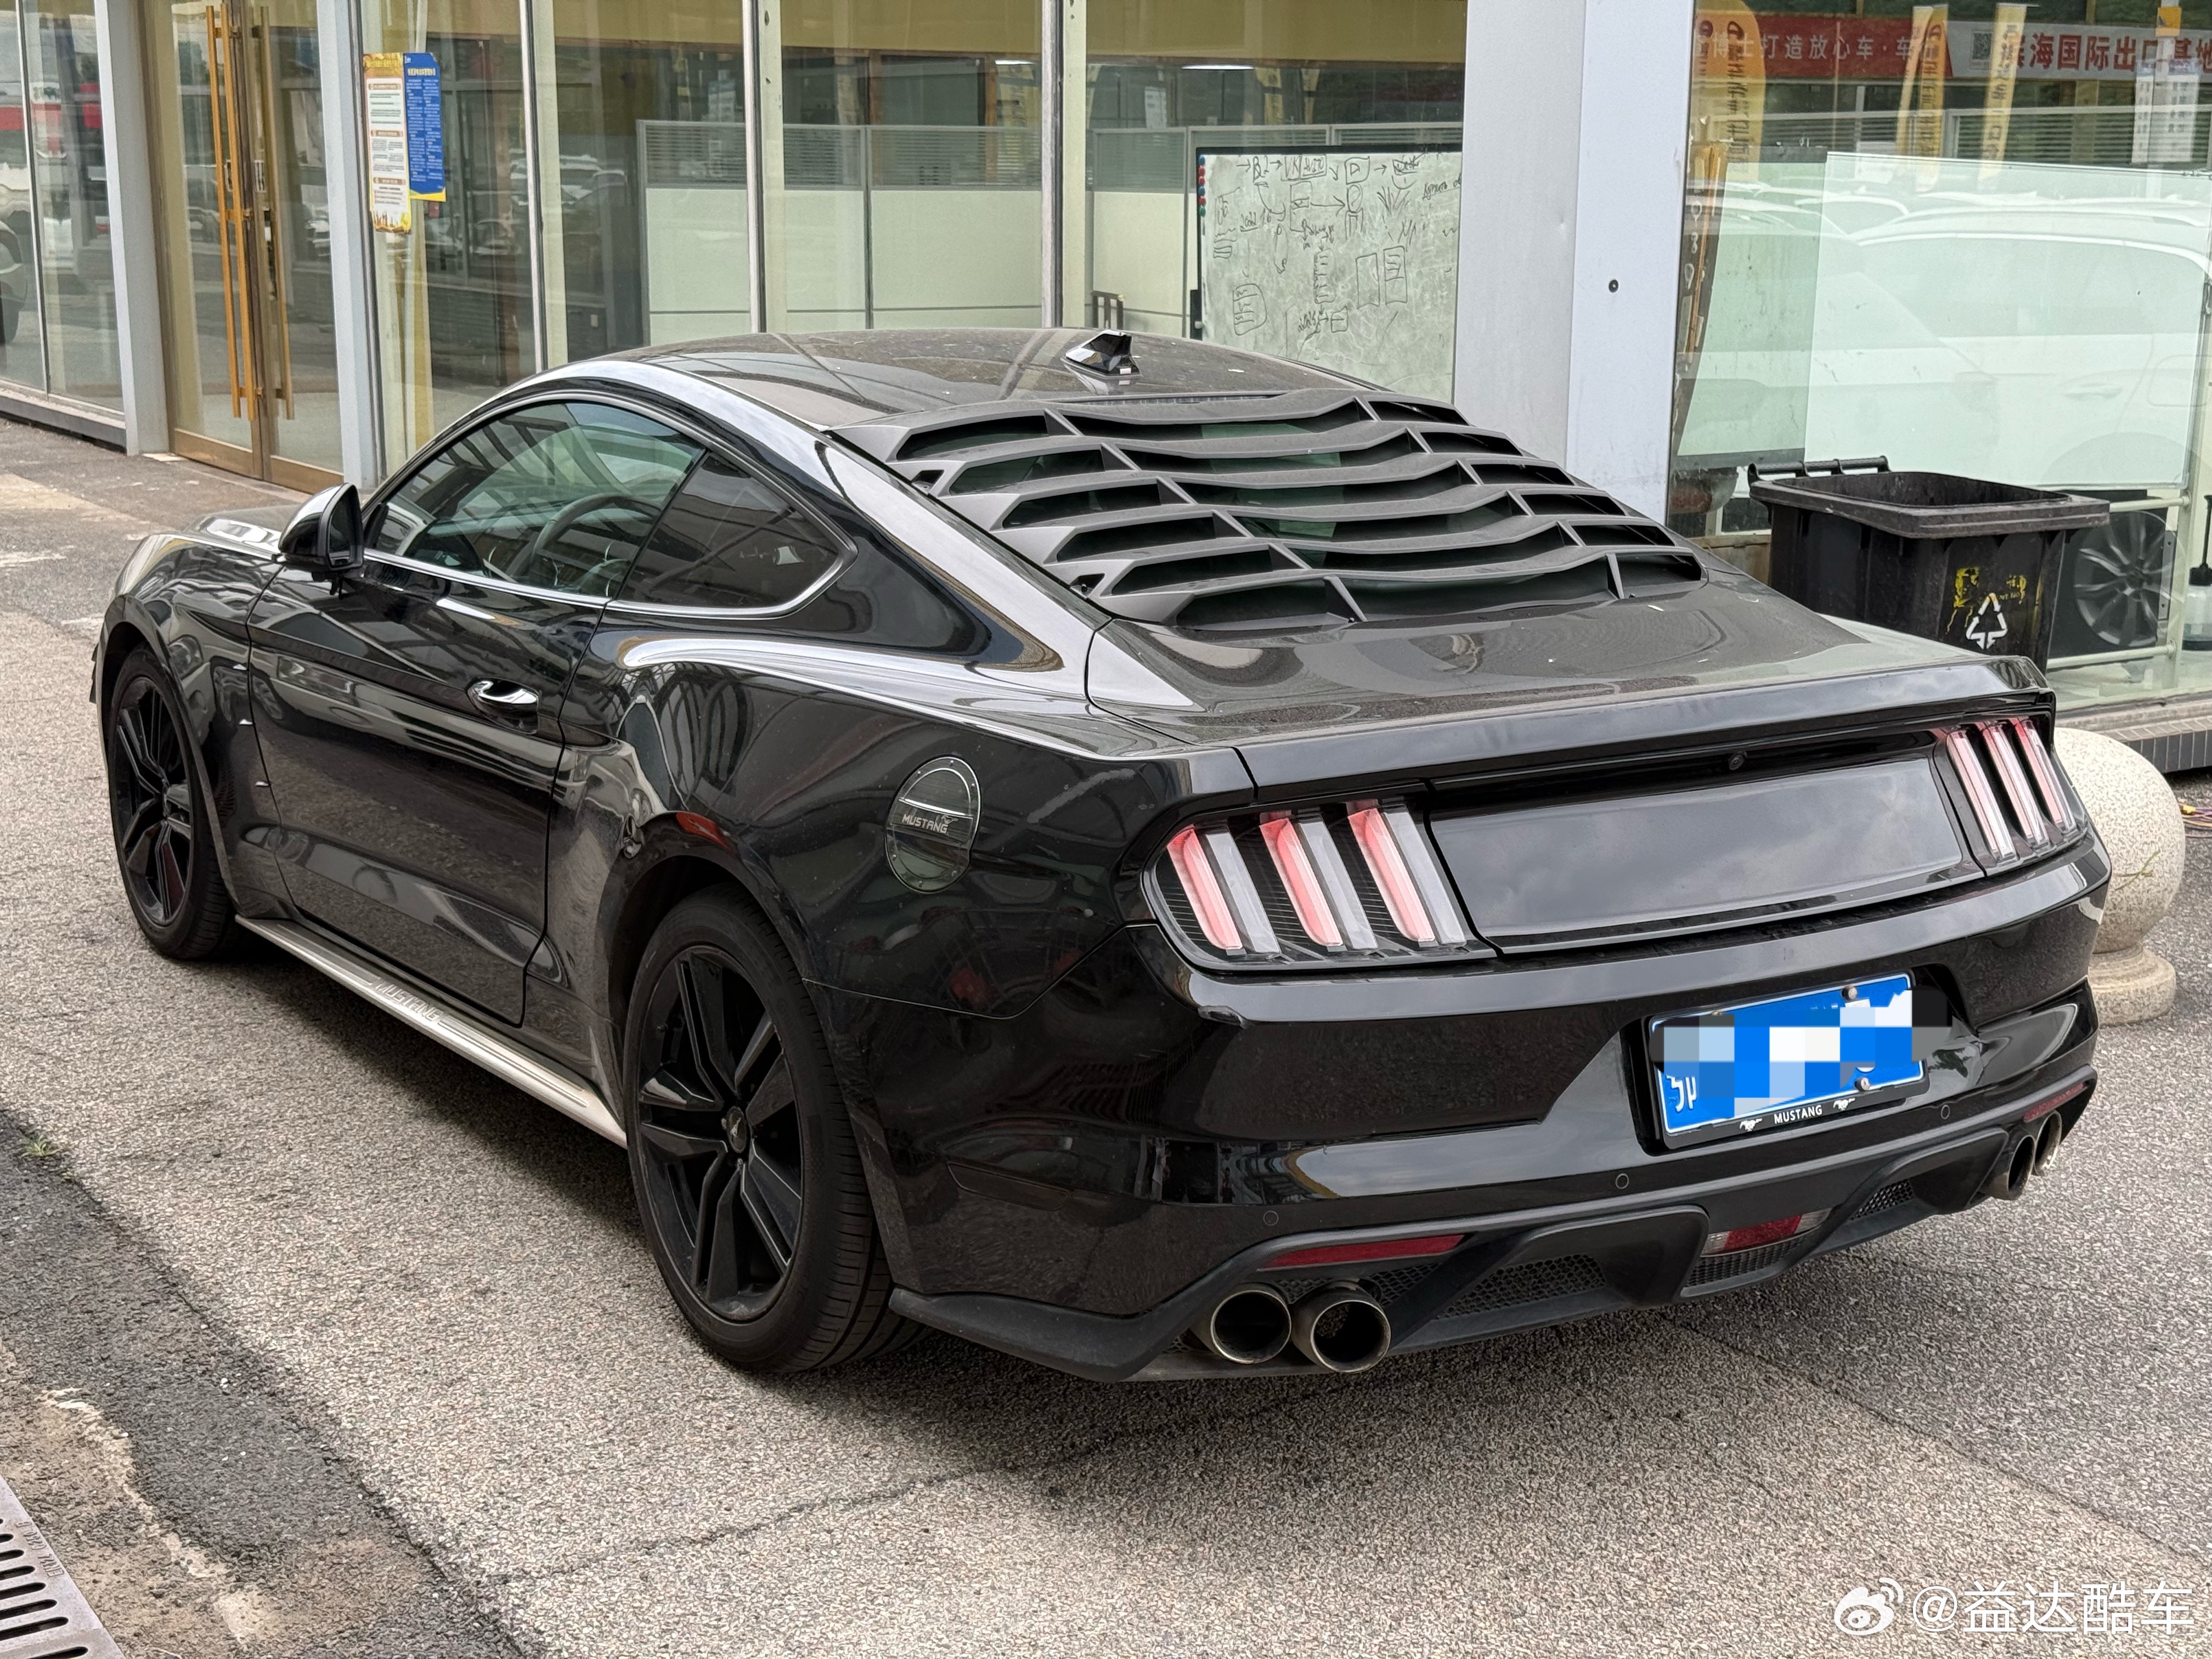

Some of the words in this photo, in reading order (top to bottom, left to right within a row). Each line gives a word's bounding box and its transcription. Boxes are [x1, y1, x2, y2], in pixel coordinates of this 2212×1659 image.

[902, 814, 949, 834] MUSTANG
[374, 983, 444, 1022] MUSTANG
[1773, 1104, 1822, 1125] MUSTANG
